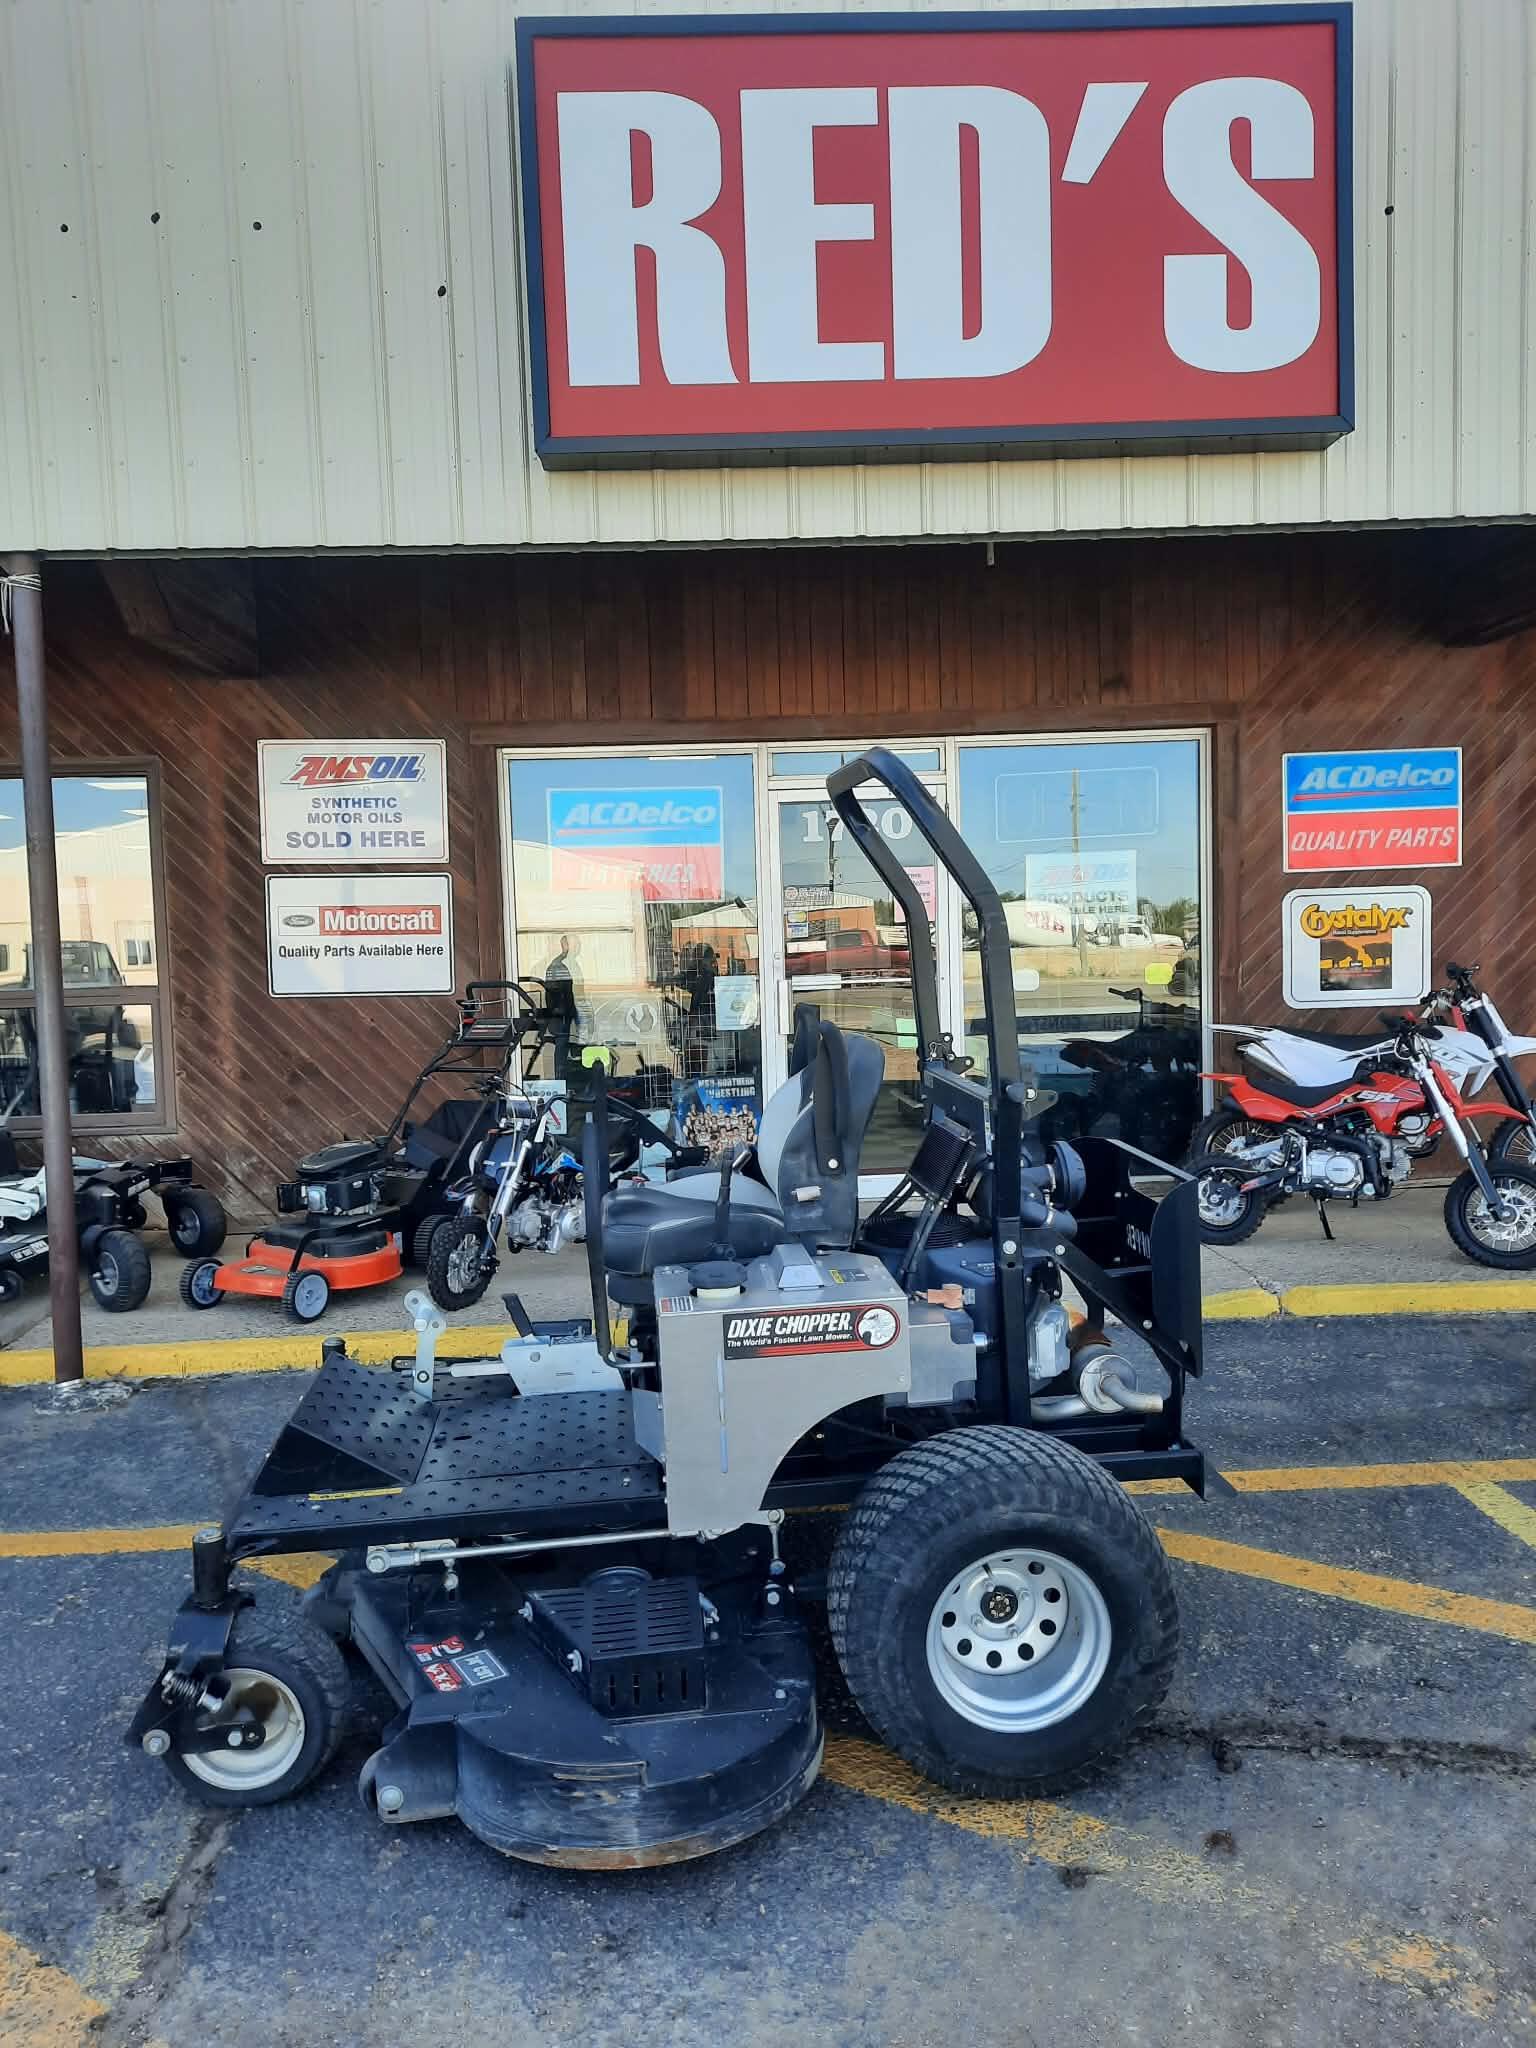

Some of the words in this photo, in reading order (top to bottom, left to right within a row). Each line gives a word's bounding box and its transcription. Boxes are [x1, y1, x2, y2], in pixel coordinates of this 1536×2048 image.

[556, 75, 1321, 387] RED'S
[289, 756, 420, 785] AMSOIL
[1299, 763, 1456, 791] ACDelco
[311, 797, 398, 809] SYNTHETIC
[564, 799, 716, 826] ACDelco
[307, 812, 363, 824] MOTOR
[367, 812, 403, 824] OILS
[286, 831, 352, 848] SOLD
[360, 830, 426, 848] HERE
[1291, 830, 1383, 852] QUALITY
[1385, 826, 1456, 849] PARTS
[324, 910, 435, 931] Motorcraft
[1300, 904, 1410, 938] Crystalyx
[278, 945, 320, 959] Quality
[324, 944, 355, 957] Parts
[358, 943, 413, 956] Available
[416, 944, 444, 956] Here
[727, 1317, 773, 1338] DIXIE
[775, 1312, 851, 1335] CHOPPER
[727, 1339, 741, 1347] The
[743, 1336, 772, 1346] World's
[773, 1335, 801, 1344] Fastest
[803, 1334, 823, 1342] Lawn
